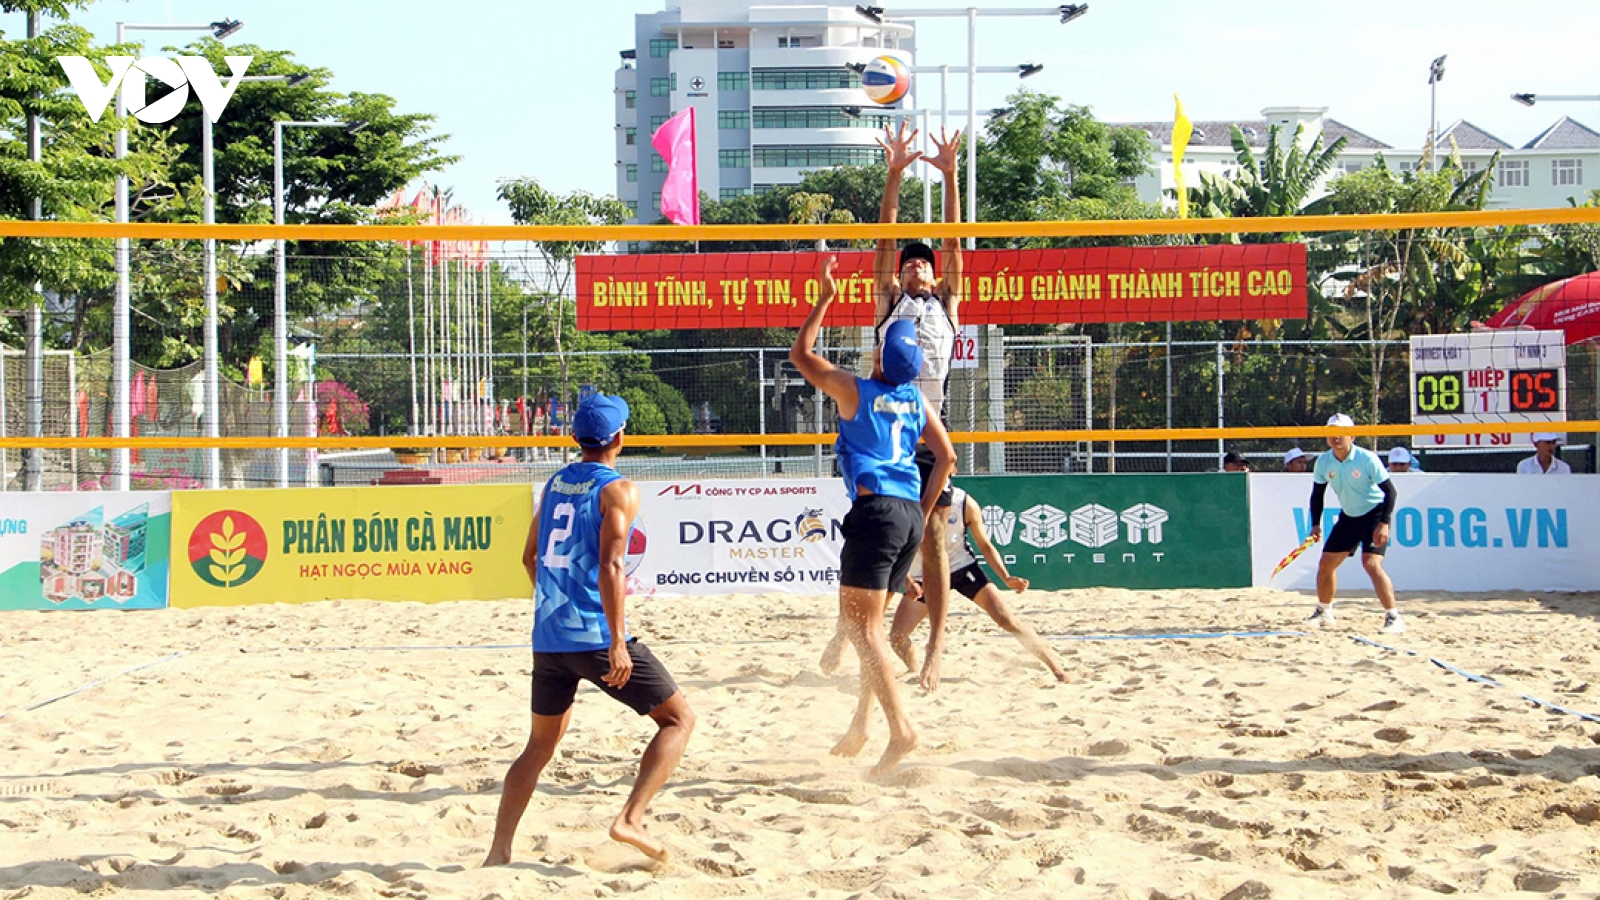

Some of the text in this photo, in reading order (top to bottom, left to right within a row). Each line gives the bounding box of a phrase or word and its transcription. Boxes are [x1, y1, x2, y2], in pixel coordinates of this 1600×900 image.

[593, 277, 648, 307] BÌNH
[655, 276, 713, 308] TĨNH,
[720, 278, 749, 311] TỰ
[754, 279, 797, 308] TIN,
[805, 270, 874, 306] QYẾT
[978, 267, 1023, 301] ĐẤU
[1031, 269, 1101, 302] GIÀNH
[1107, 268, 1182, 299] THÀNH
[1190, 267, 1241, 298] TÍCH
[1248, 269, 1292, 297] CAO
[951, 331, 975, 361] Ố 2
[1418, 375, 1460, 411] 08
[1468, 366, 1505, 391] HIỆP
[1512, 372, 1557, 409] 05
[1480, 391, 1489, 412] 1
[891, 420, 904, 463] 1
[704, 486, 817, 497] CÔNG TY CP AA SPORTS
[282, 511, 492, 554] PHÂN BÓN CÀ MAU
[543, 502, 576, 569] 2
[729, 547, 805, 559] MASTER
[299, 558, 473, 581] HẠT NGỌC MÙA VÀNG
[656, 570, 701, 585] BÓNG
[705, 566, 770, 584] CHUYỀN
[774, 565, 794, 582] SỐ
[798, 571, 804, 581] 1
